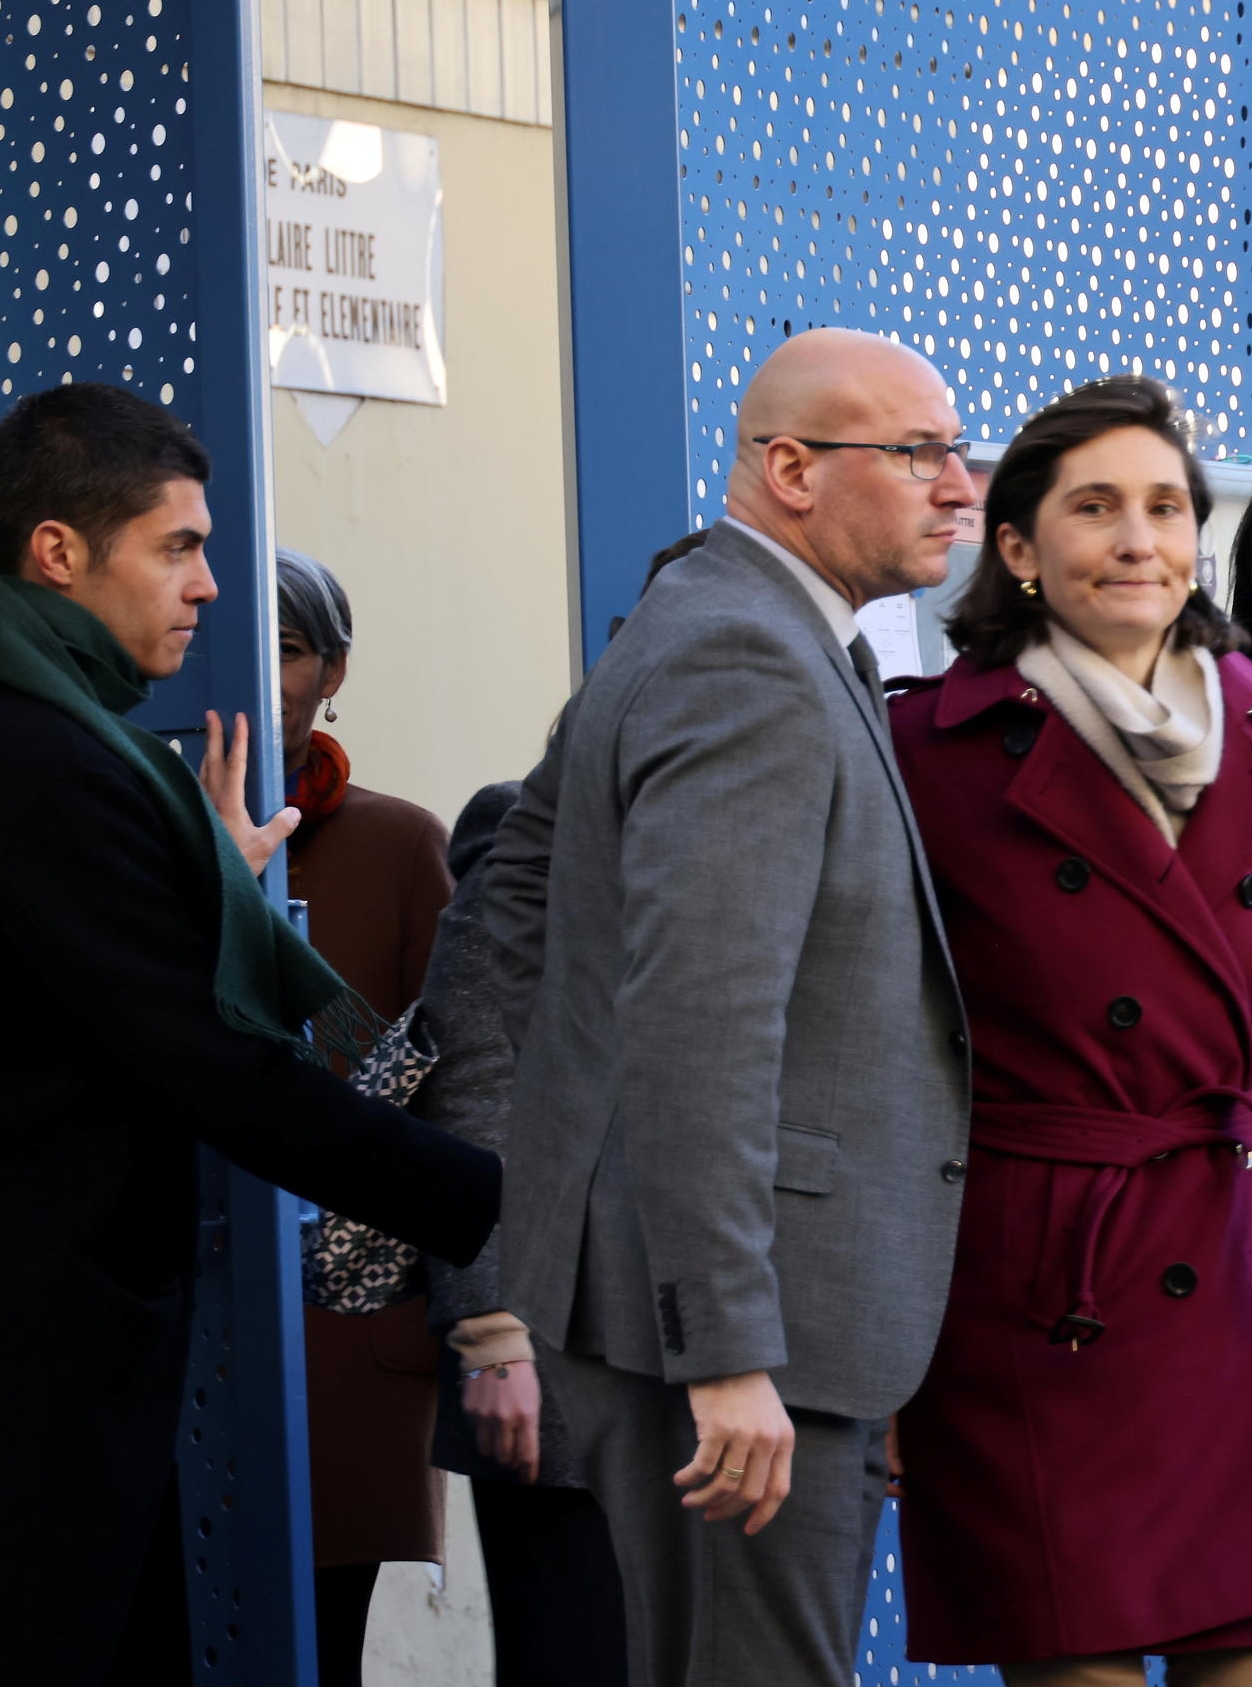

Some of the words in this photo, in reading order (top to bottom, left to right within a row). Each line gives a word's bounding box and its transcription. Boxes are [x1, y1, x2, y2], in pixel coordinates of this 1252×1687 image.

[290, 162, 347, 198] PARIS
[267, 219, 312, 271] LAIRE
[325, 228, 376, 280] LITTRE
[293, 289, 310, 334] ET
[320, 292, 421, 350] ELEMENTAIRE
